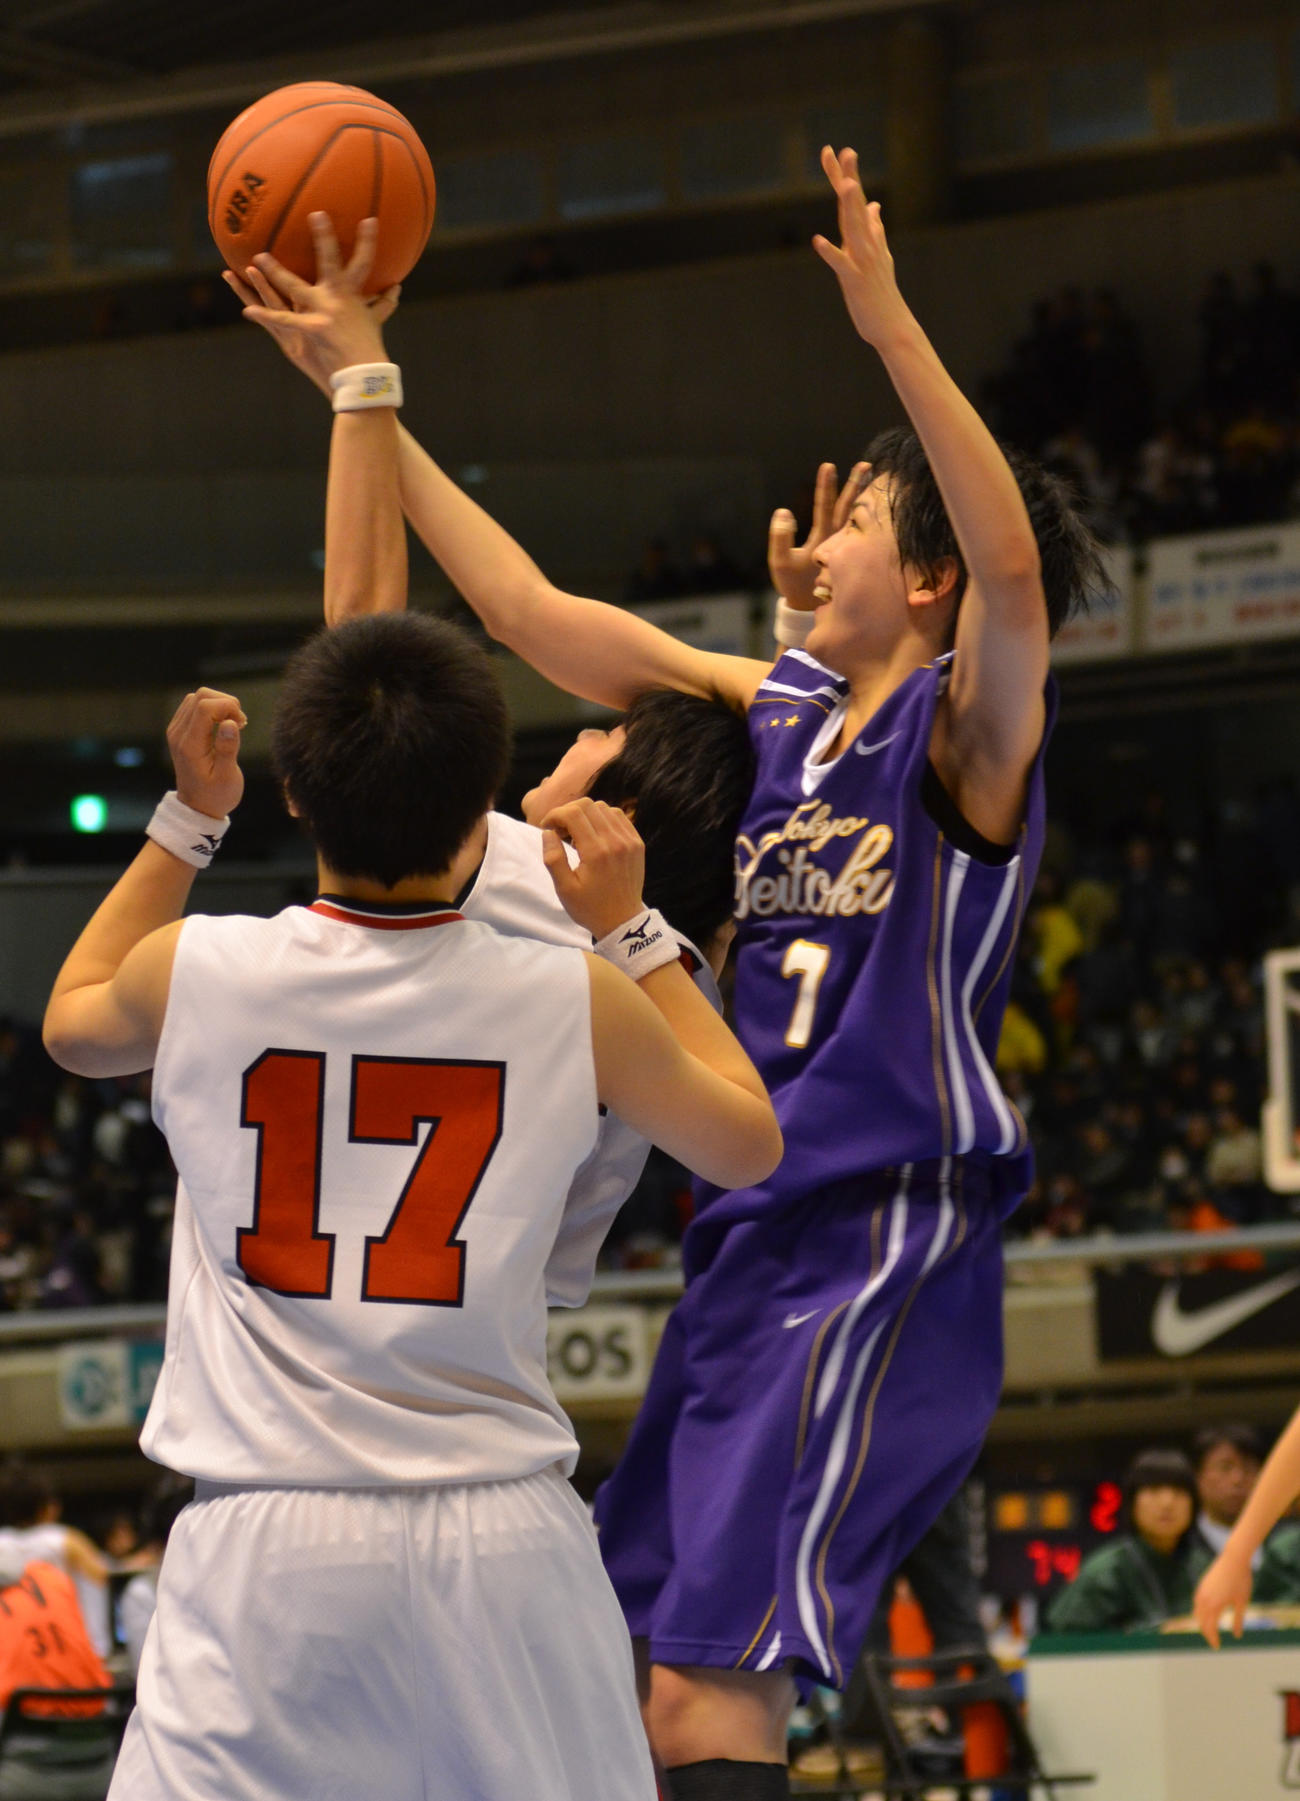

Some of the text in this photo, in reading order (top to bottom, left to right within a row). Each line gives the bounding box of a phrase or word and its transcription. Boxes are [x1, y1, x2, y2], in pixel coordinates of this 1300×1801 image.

[781, 798, 869, 852] Tokyo
[781, 938, 831, 1049] 7
[236, 1047, 507, 1308] 17
